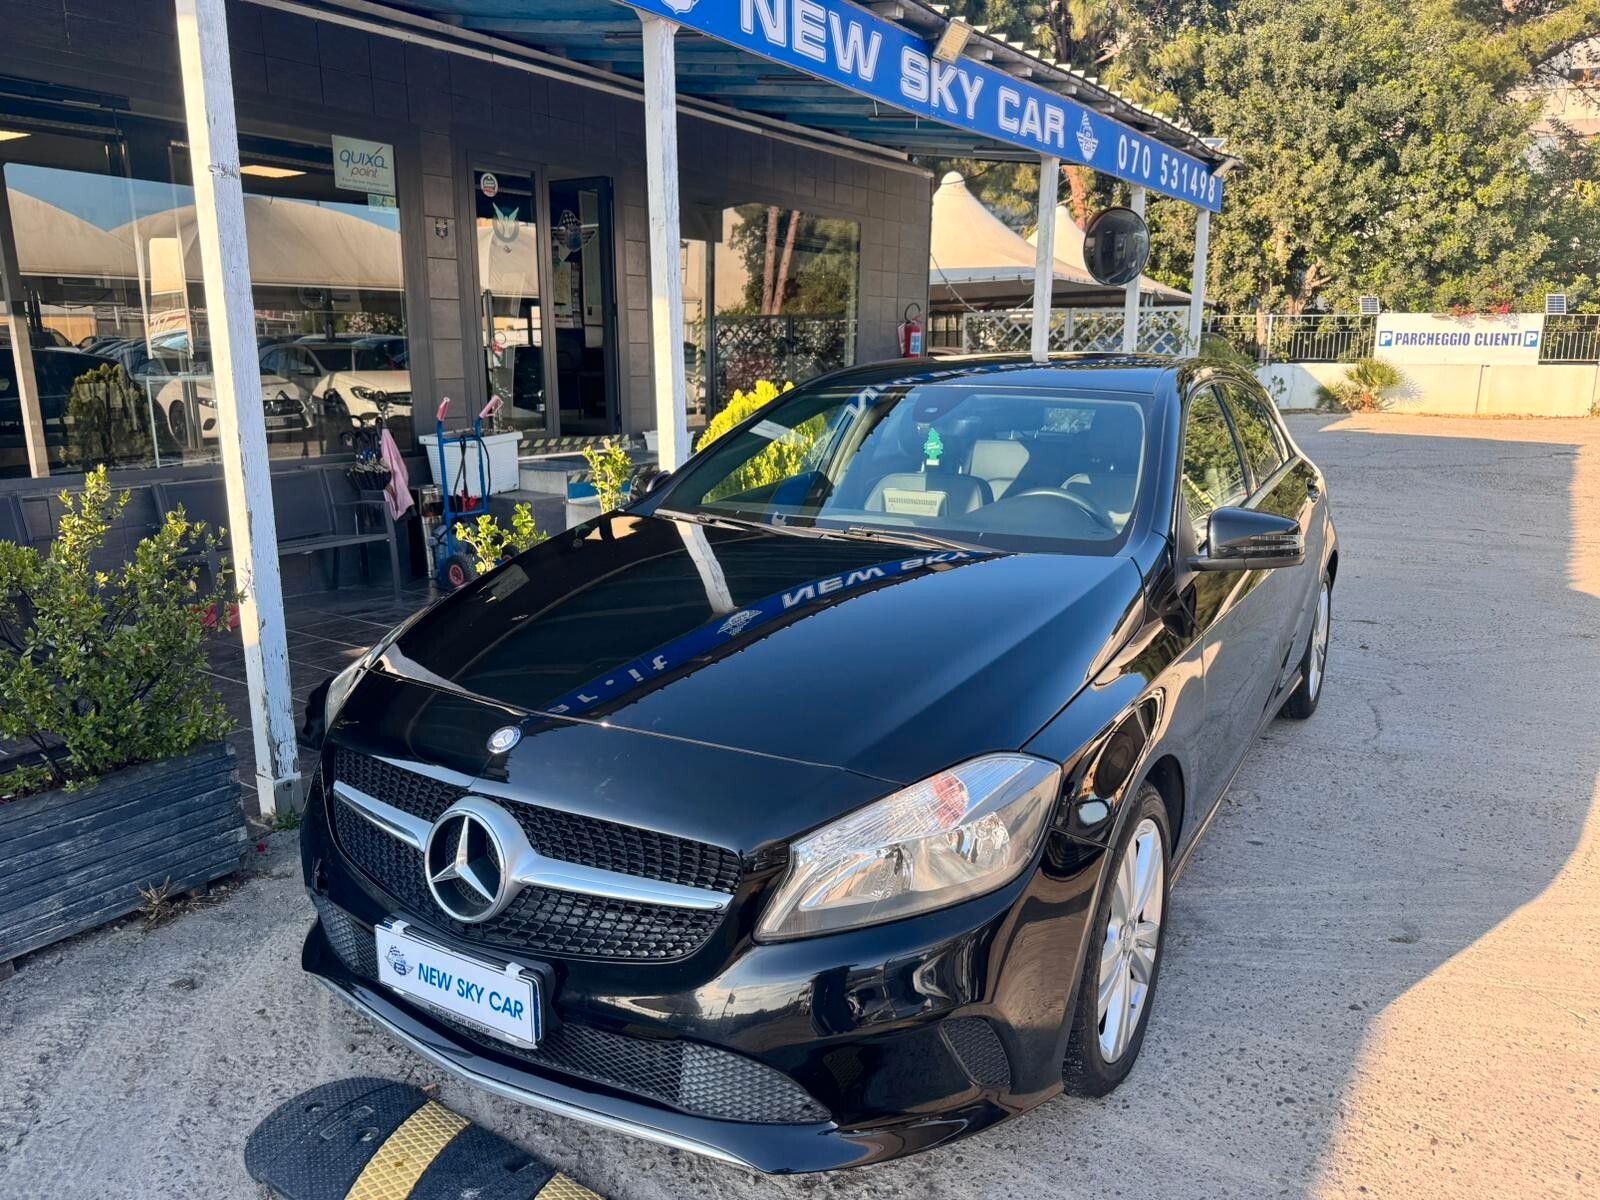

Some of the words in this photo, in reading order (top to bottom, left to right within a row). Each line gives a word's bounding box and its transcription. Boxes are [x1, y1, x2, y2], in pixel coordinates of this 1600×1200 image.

[741, 0, 882, 82] NEW
[901, 45, 985, 120] SKY
[998, 85, 1065, 149] CAR
[351, 166, 379, 178] point
[1118, 134, 1151, 179] 070
[1160, 152, 1216, 203] 531498
[1379, 331, 1393, 346] P
[1395, 332, 1471, 346] PARCHEGGIO
[1474, 332, 1522, 346] CLIENTI
[1524, 331, 1539, 347] P
[418, 962, 452, 992] NEW
[457, 978, 485, 1004] SKY
[489, 991, 524, 1020] CAR
